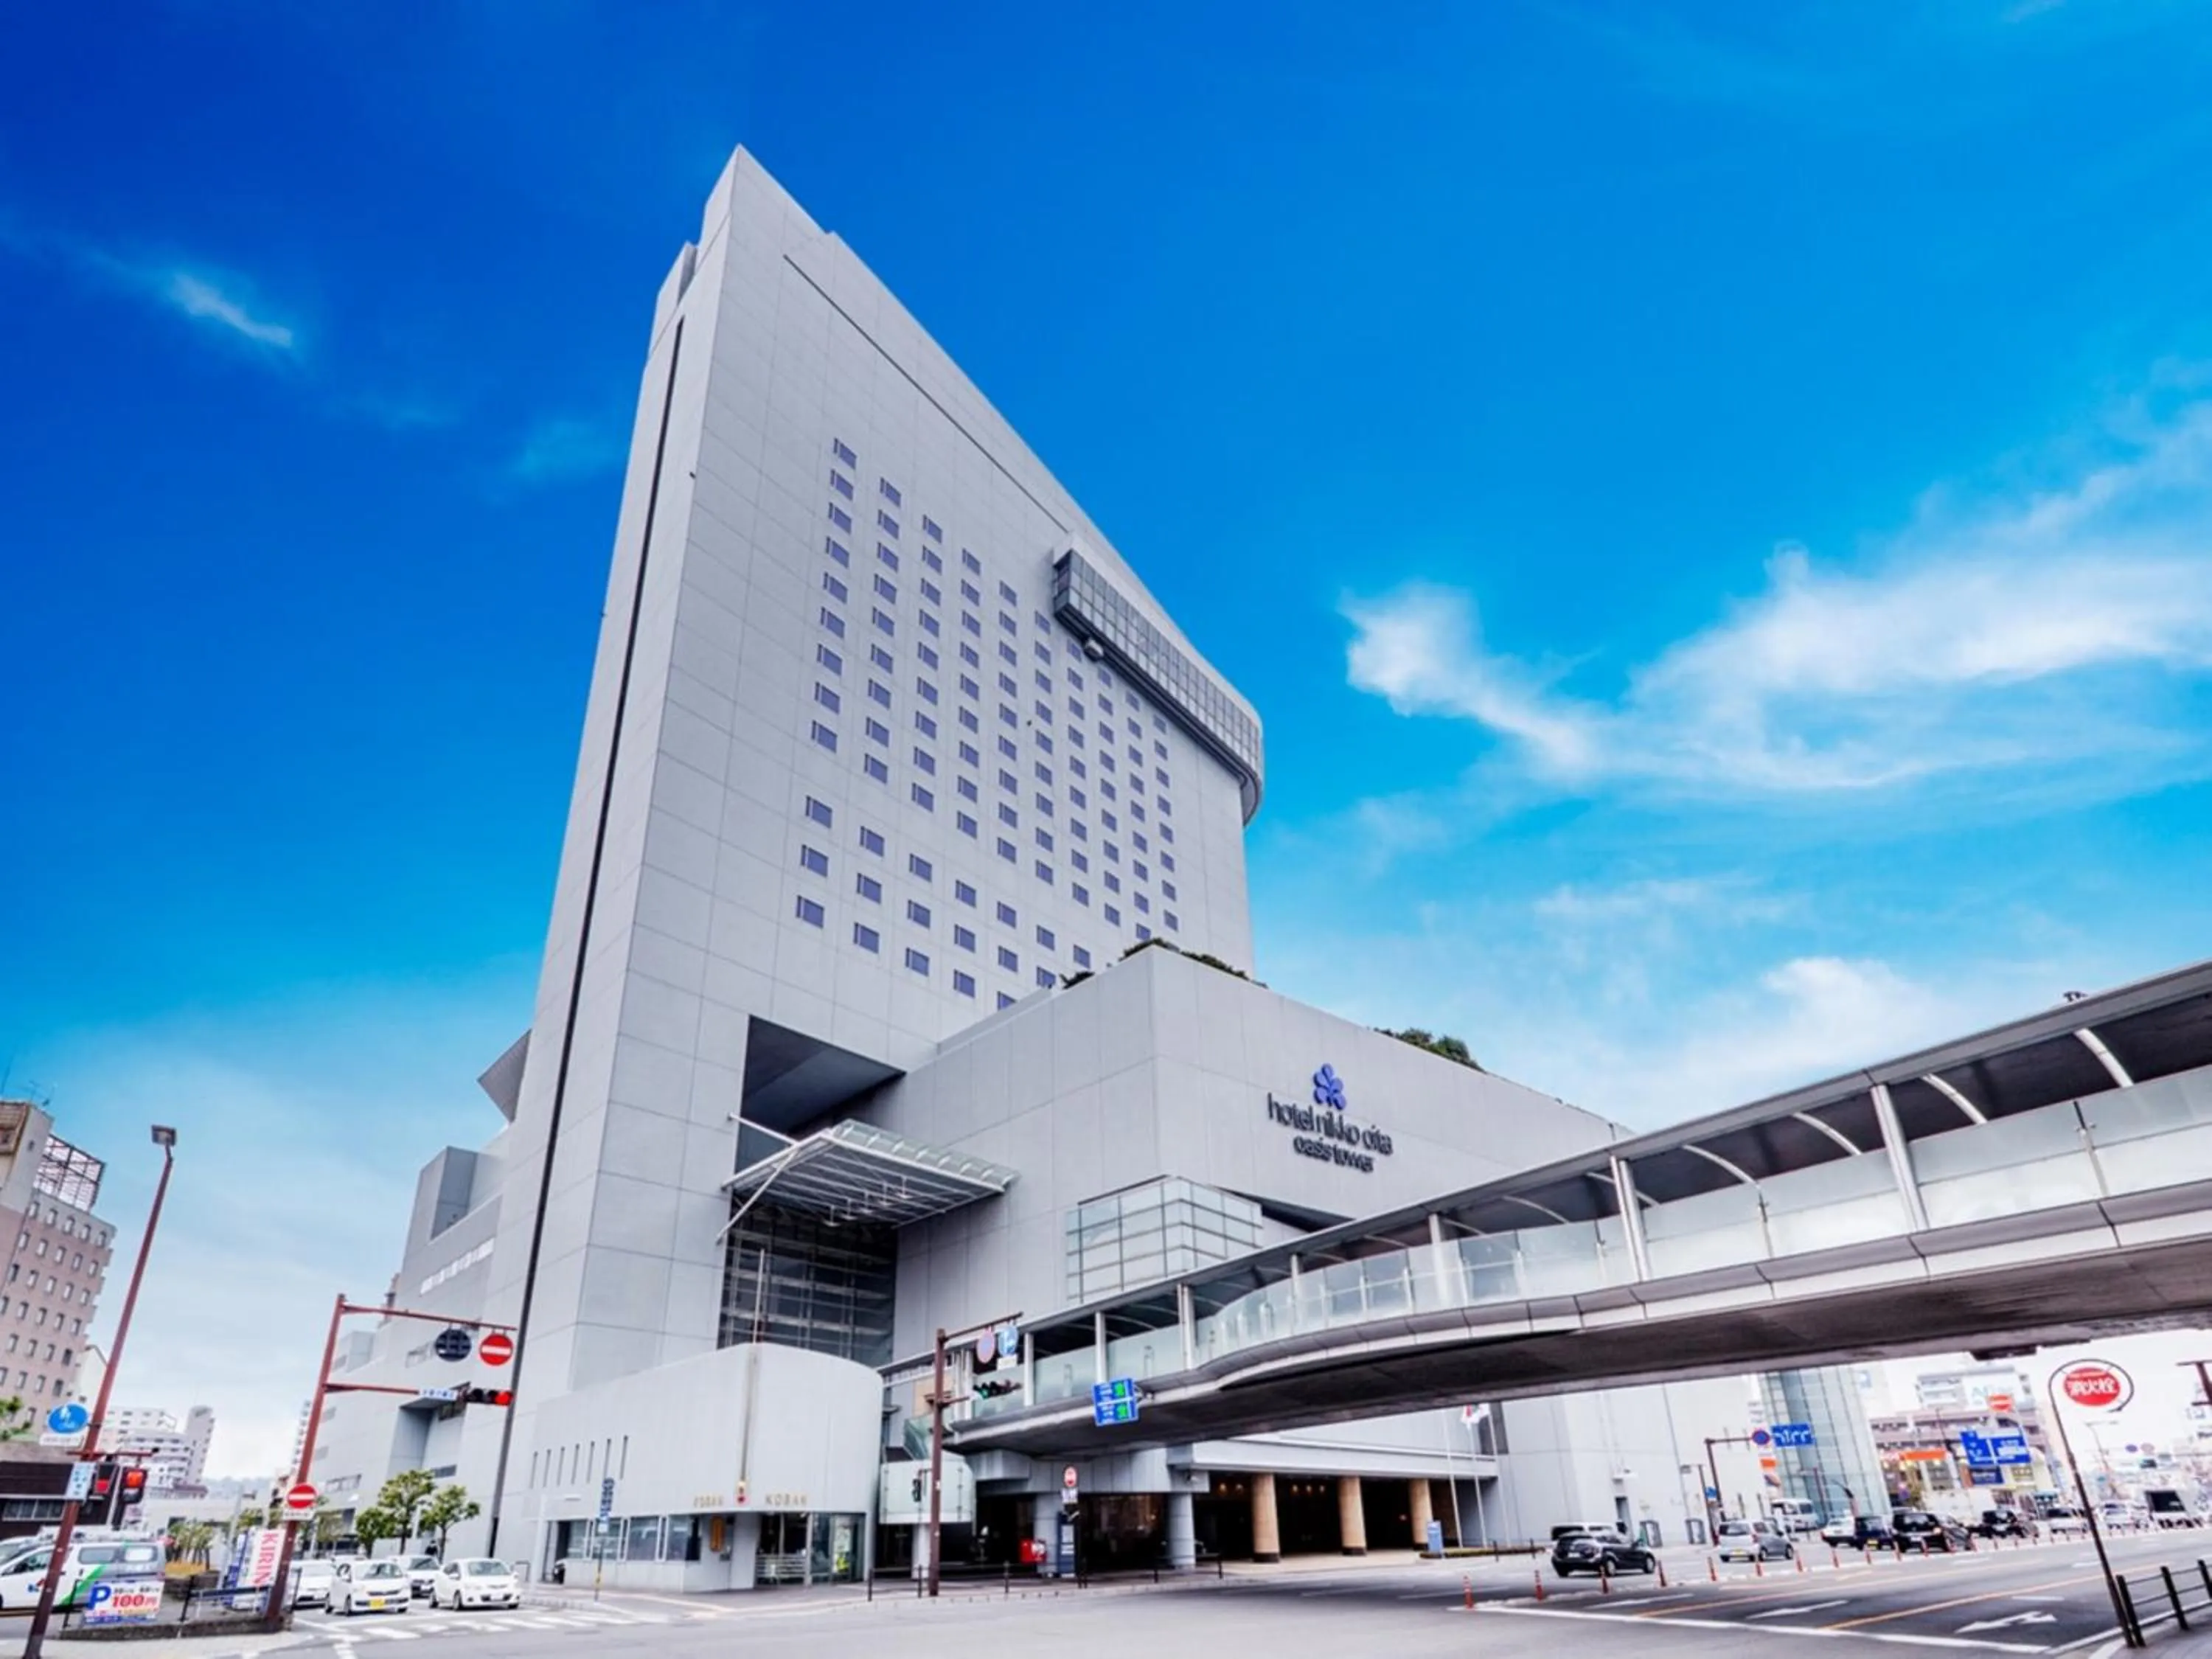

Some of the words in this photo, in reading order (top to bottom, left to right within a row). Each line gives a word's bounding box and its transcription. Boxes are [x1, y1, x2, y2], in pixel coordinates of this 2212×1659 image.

[1266, 1092, 1314, 1131] hotel
[1316, 1111, 1360, 1145] nikko
[1362, 1124, 1393, 1156] oita
[1293, 1135, 1332, 1163] oasis
[765, 1494, 807, 1506] KOBAN
[253, 1533, 279, 1585] KIRIN
[88, 1586, 111, 1609] P
